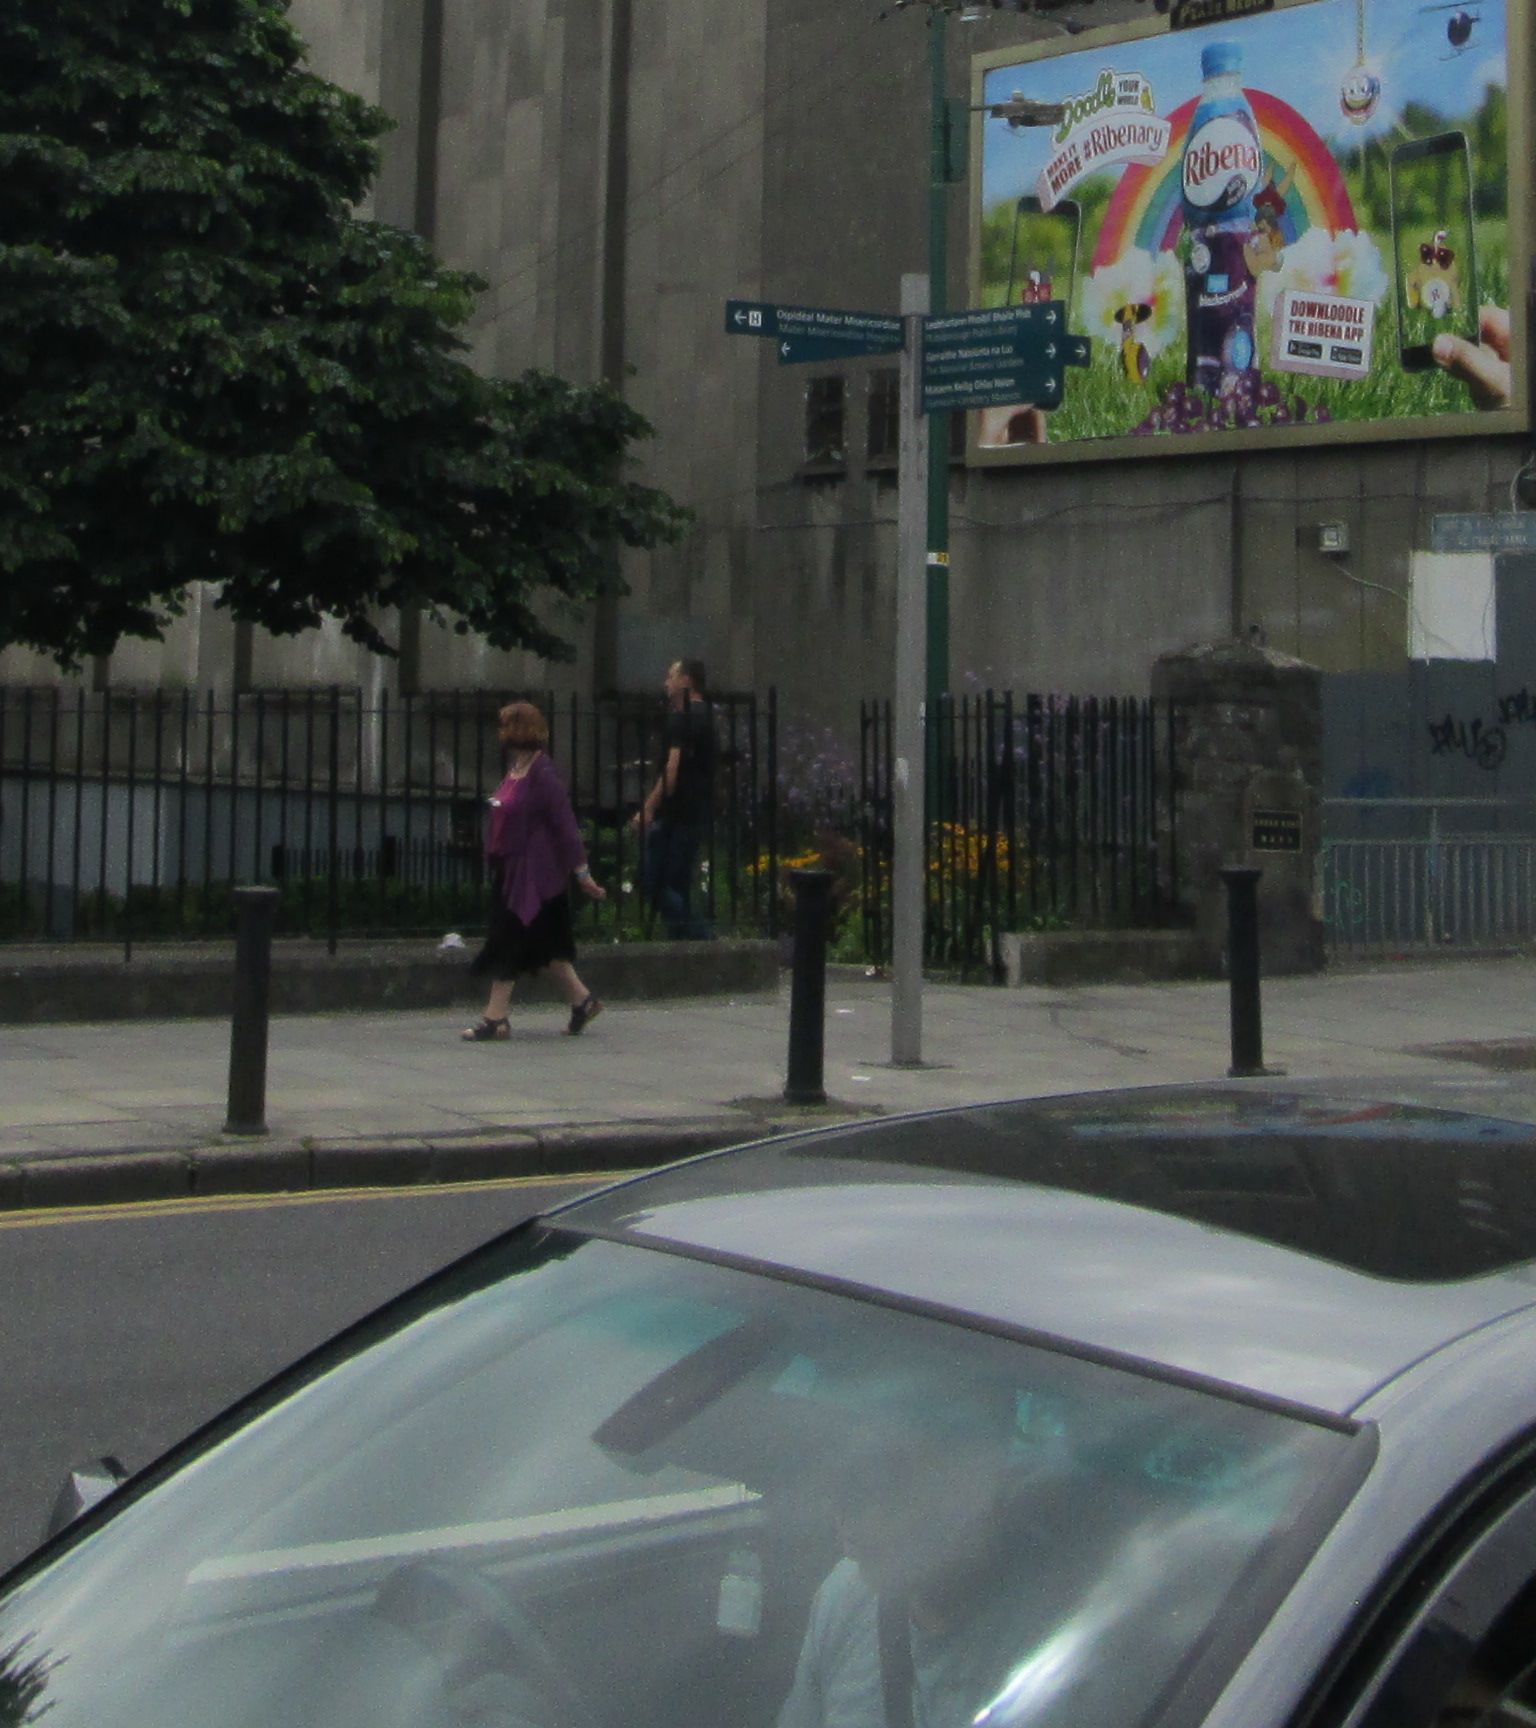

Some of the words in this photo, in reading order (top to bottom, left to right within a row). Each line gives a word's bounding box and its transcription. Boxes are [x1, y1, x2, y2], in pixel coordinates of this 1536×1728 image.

[1118, 80, 1140, 93] YOUR
[1083, 124, 1164, 161] #Ribenary
[1047, 150, 1069, 178] MAKE
[1068, 143, 1078, 157] IT
[1050, 156, 1083, 195] MORE
[1185, 141, 1258, 186] Ribena
[816, 313, 843, 325] Mater
[1290, 299, 1365, 324] DOWNLOODLE
[1289, 319, 1306, 335] THE
[1307, 322, 1343, 339] RIBENA
[1344, 326, 1365, 343] APP
